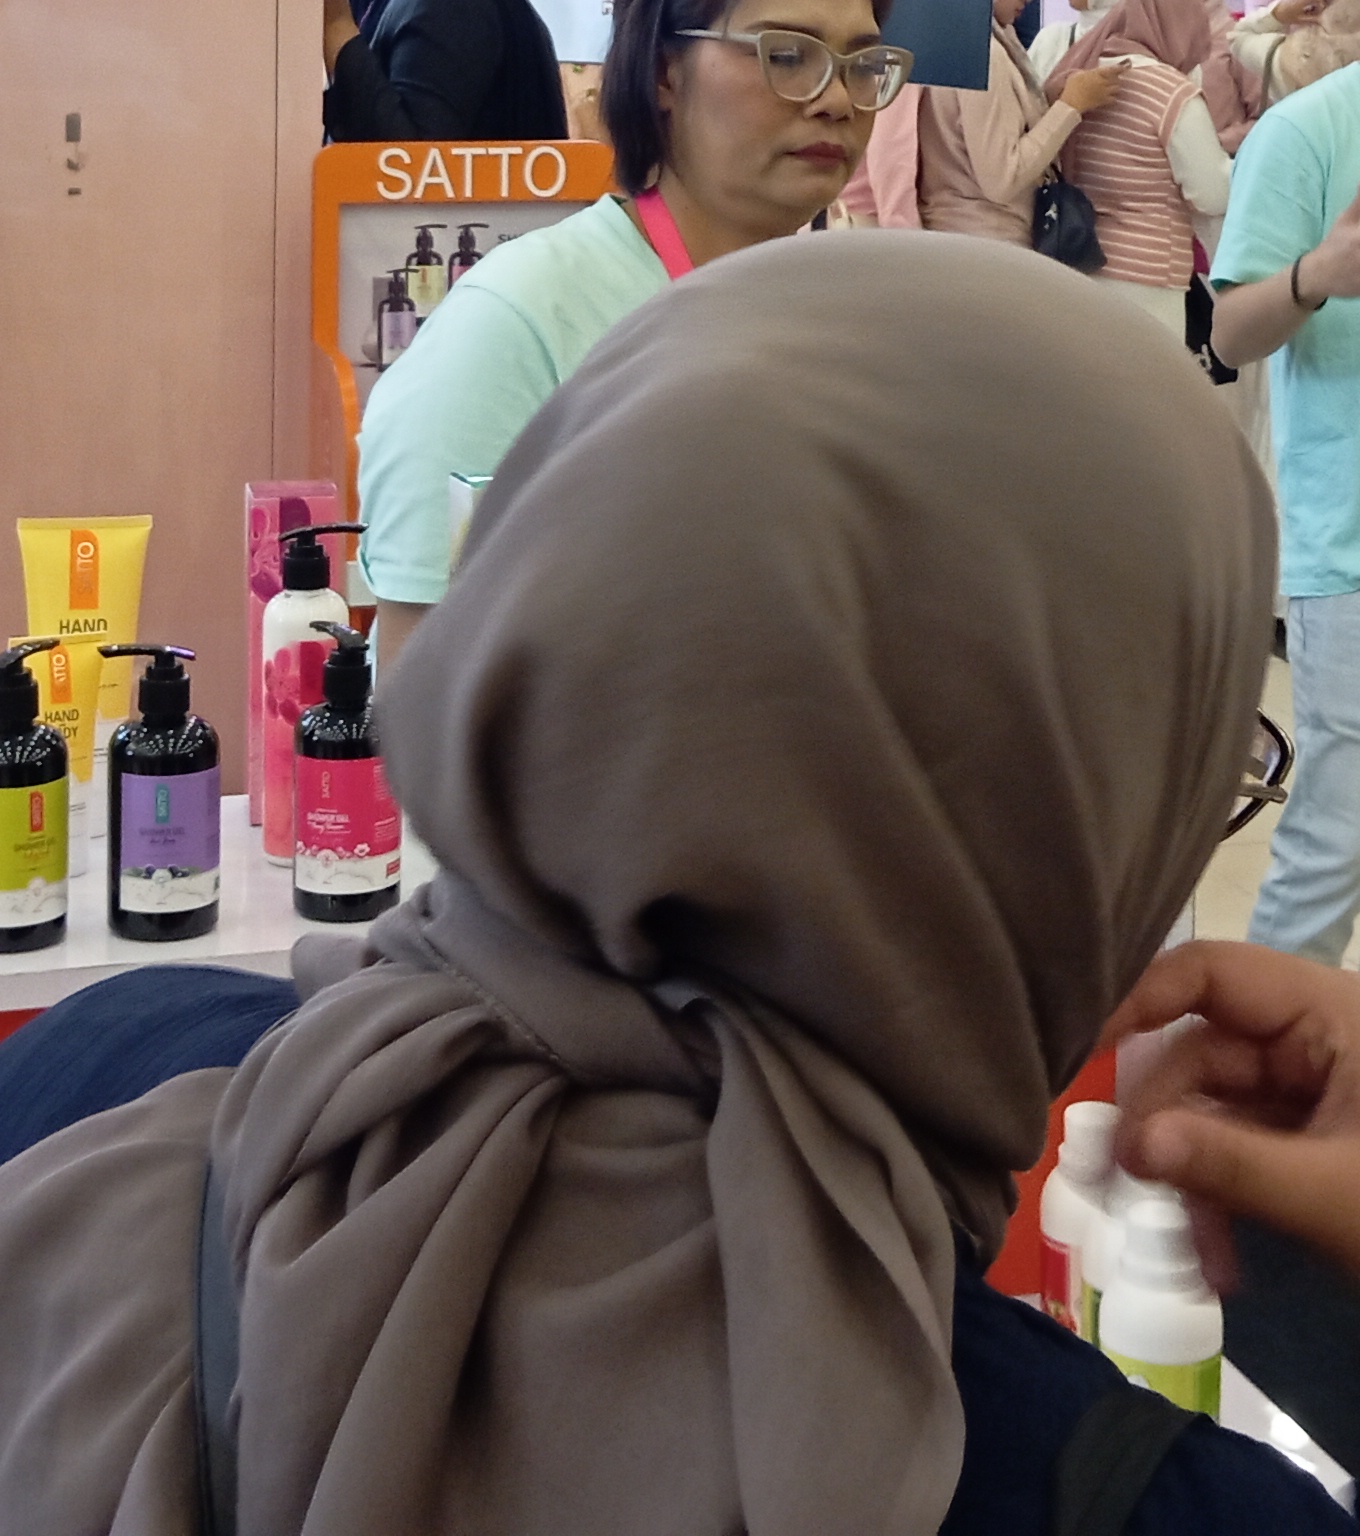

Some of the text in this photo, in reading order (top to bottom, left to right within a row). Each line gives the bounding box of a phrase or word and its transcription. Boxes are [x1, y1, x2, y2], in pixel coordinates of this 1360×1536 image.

[376, 146, 567, 200] SATTO
[59, 618, 108, 634] HAND
[44, 709, 80, 722] HAND
